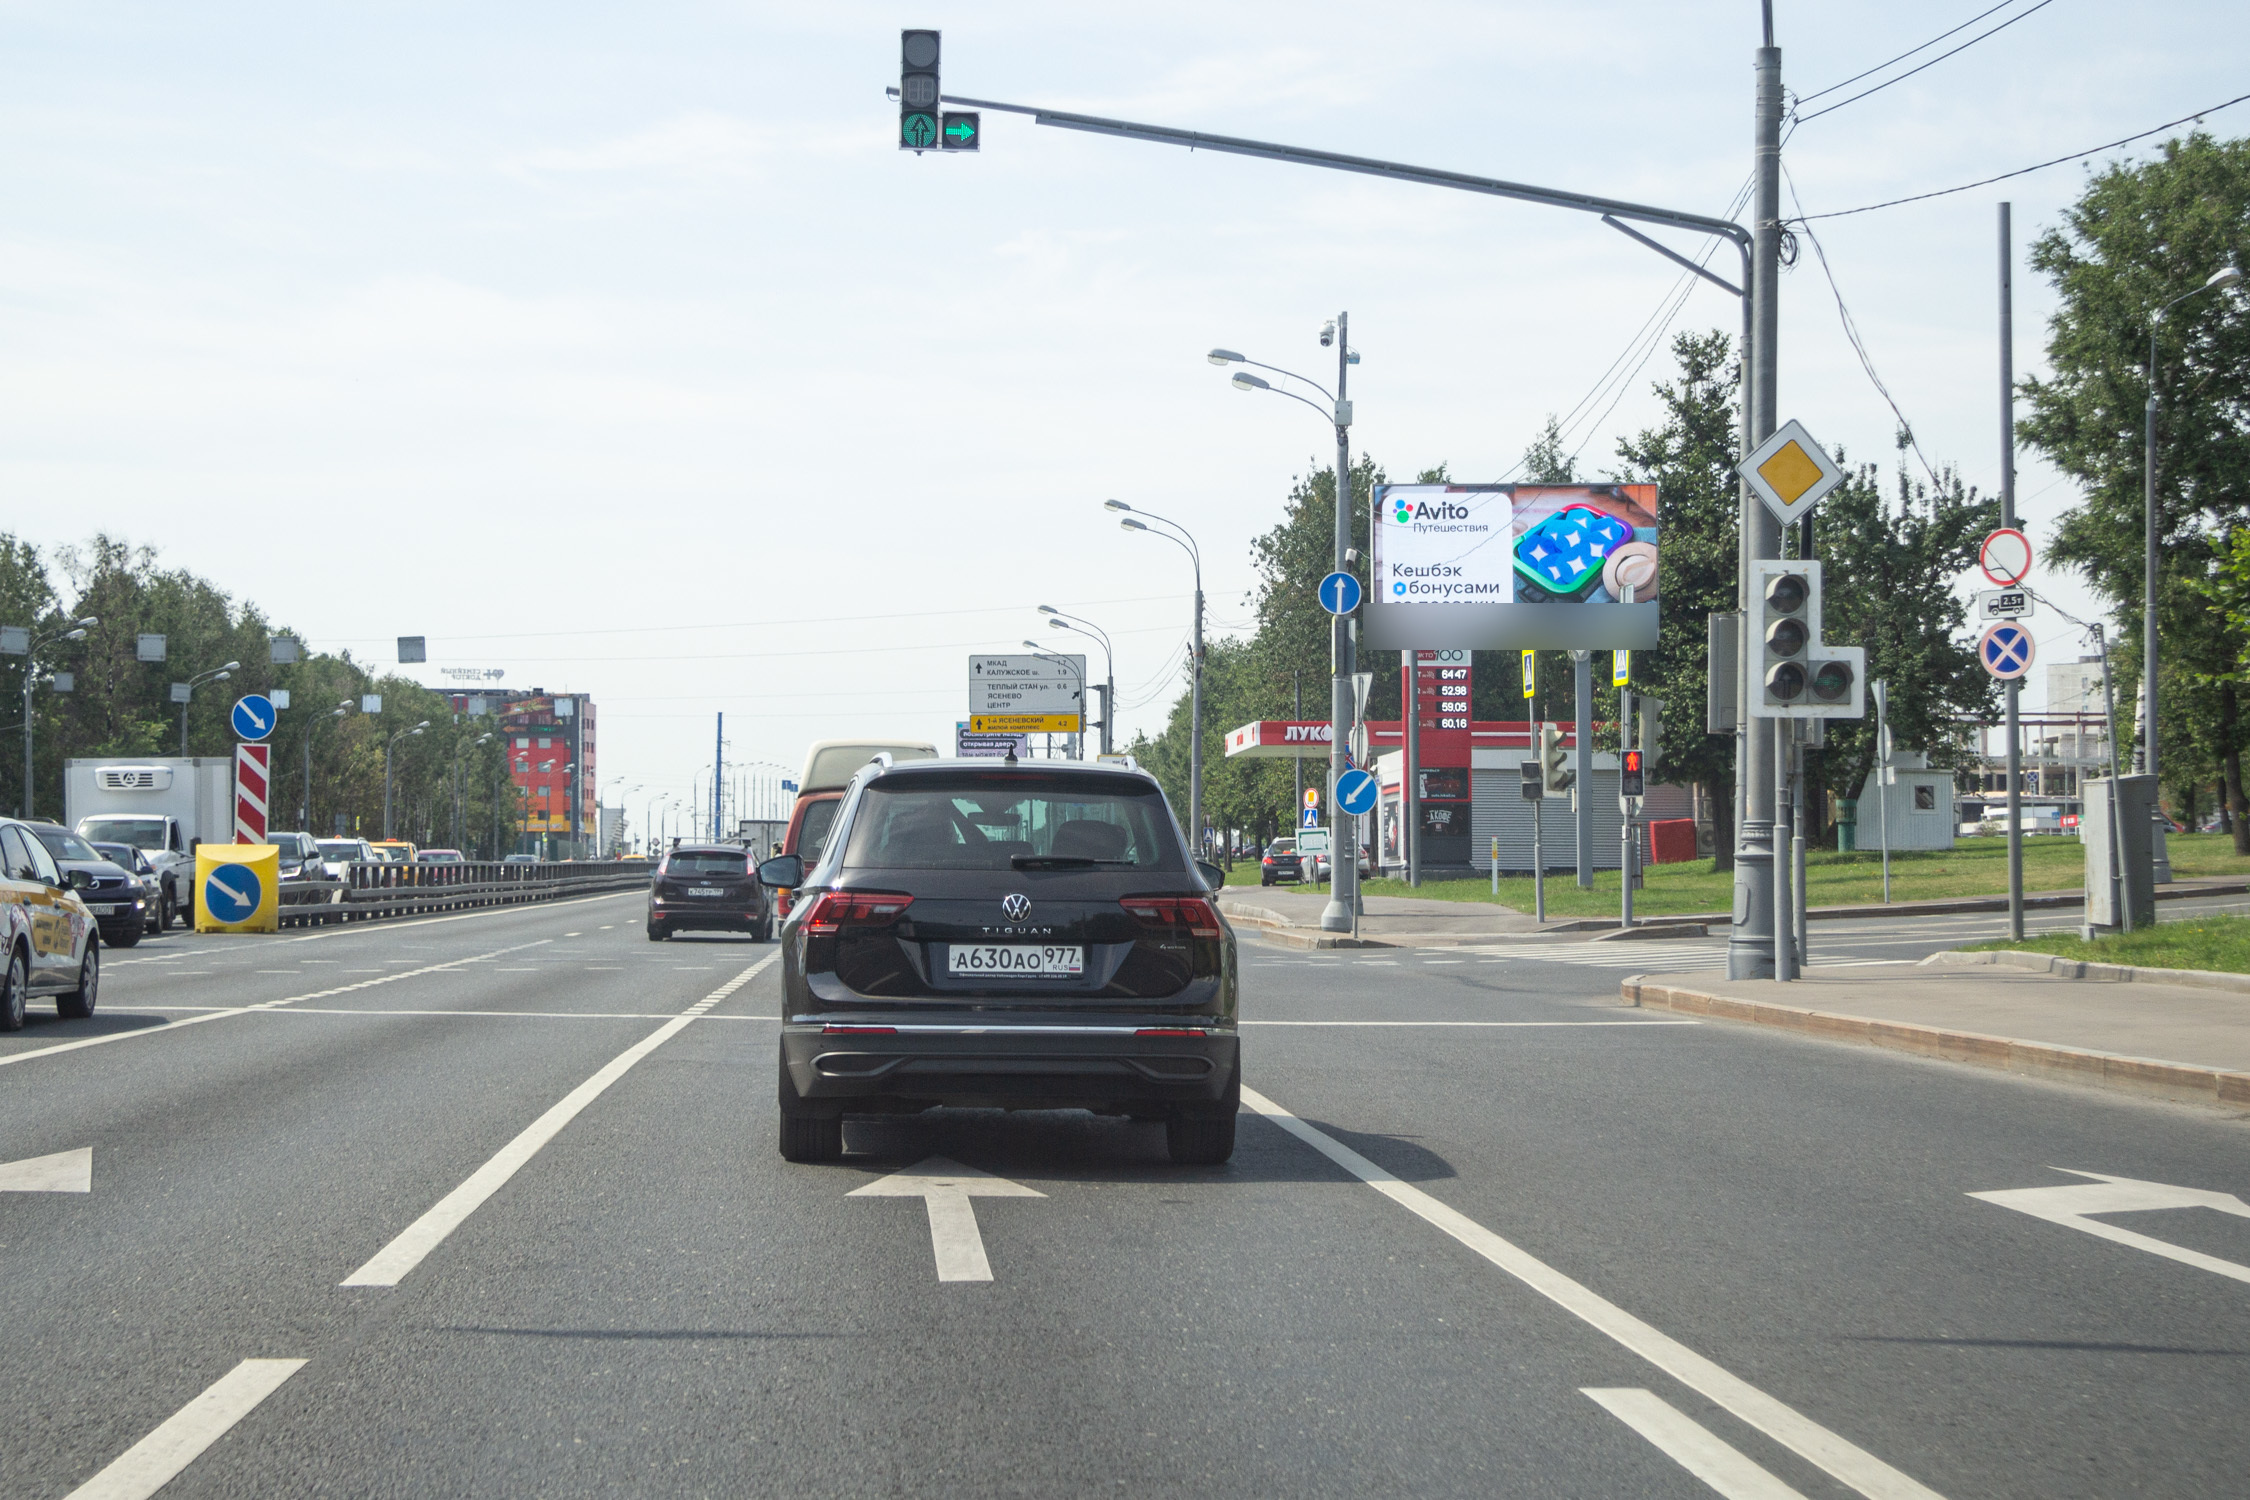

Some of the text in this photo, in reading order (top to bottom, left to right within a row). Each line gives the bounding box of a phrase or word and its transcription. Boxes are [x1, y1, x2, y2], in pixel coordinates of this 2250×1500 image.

[1414, 501, 1469, 520] Avito
[1413, 523, 1488, 534] Путешествия
[1393, 563, 1462, 577] Кешбэк
[1409, 580, 1499, 598] бонусами
[988, 682, 1018, 690] ТЕПЛЫЙ
[999, 716, 1044, 724] ЯСЕНЕВСКИЙ
[956, 948, 1076, 969] А630АО 977
